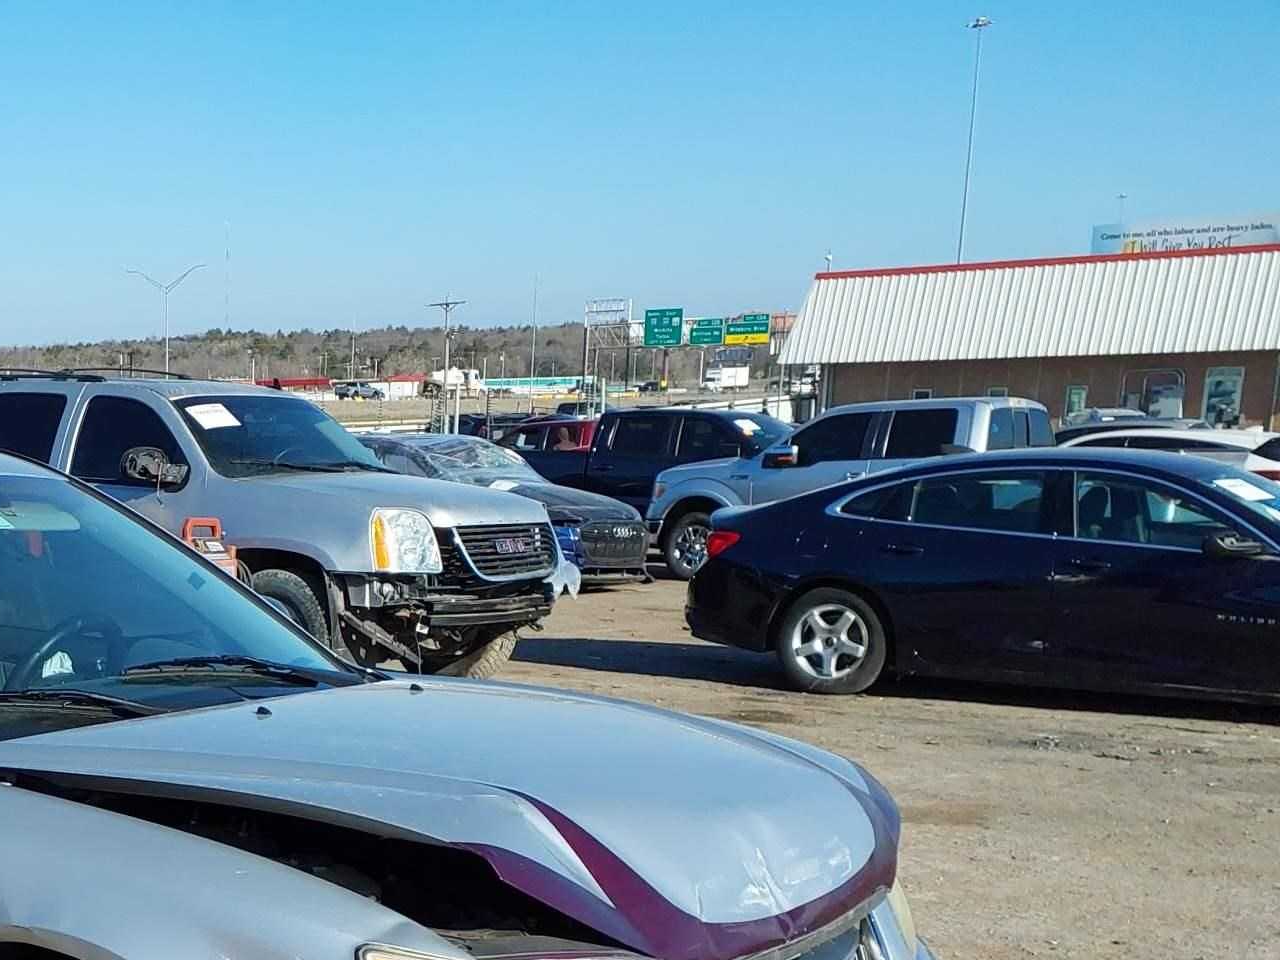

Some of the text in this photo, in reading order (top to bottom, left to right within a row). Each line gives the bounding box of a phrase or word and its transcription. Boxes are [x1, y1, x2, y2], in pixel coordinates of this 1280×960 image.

[1100, 232, 1121, 240] Come
[1157, 227, 1172, 236] who
[1174, 226, 1194, 235] labor
[1195, 224, 1211, 233] and
[1226, 224, 1249, 232] heavy
